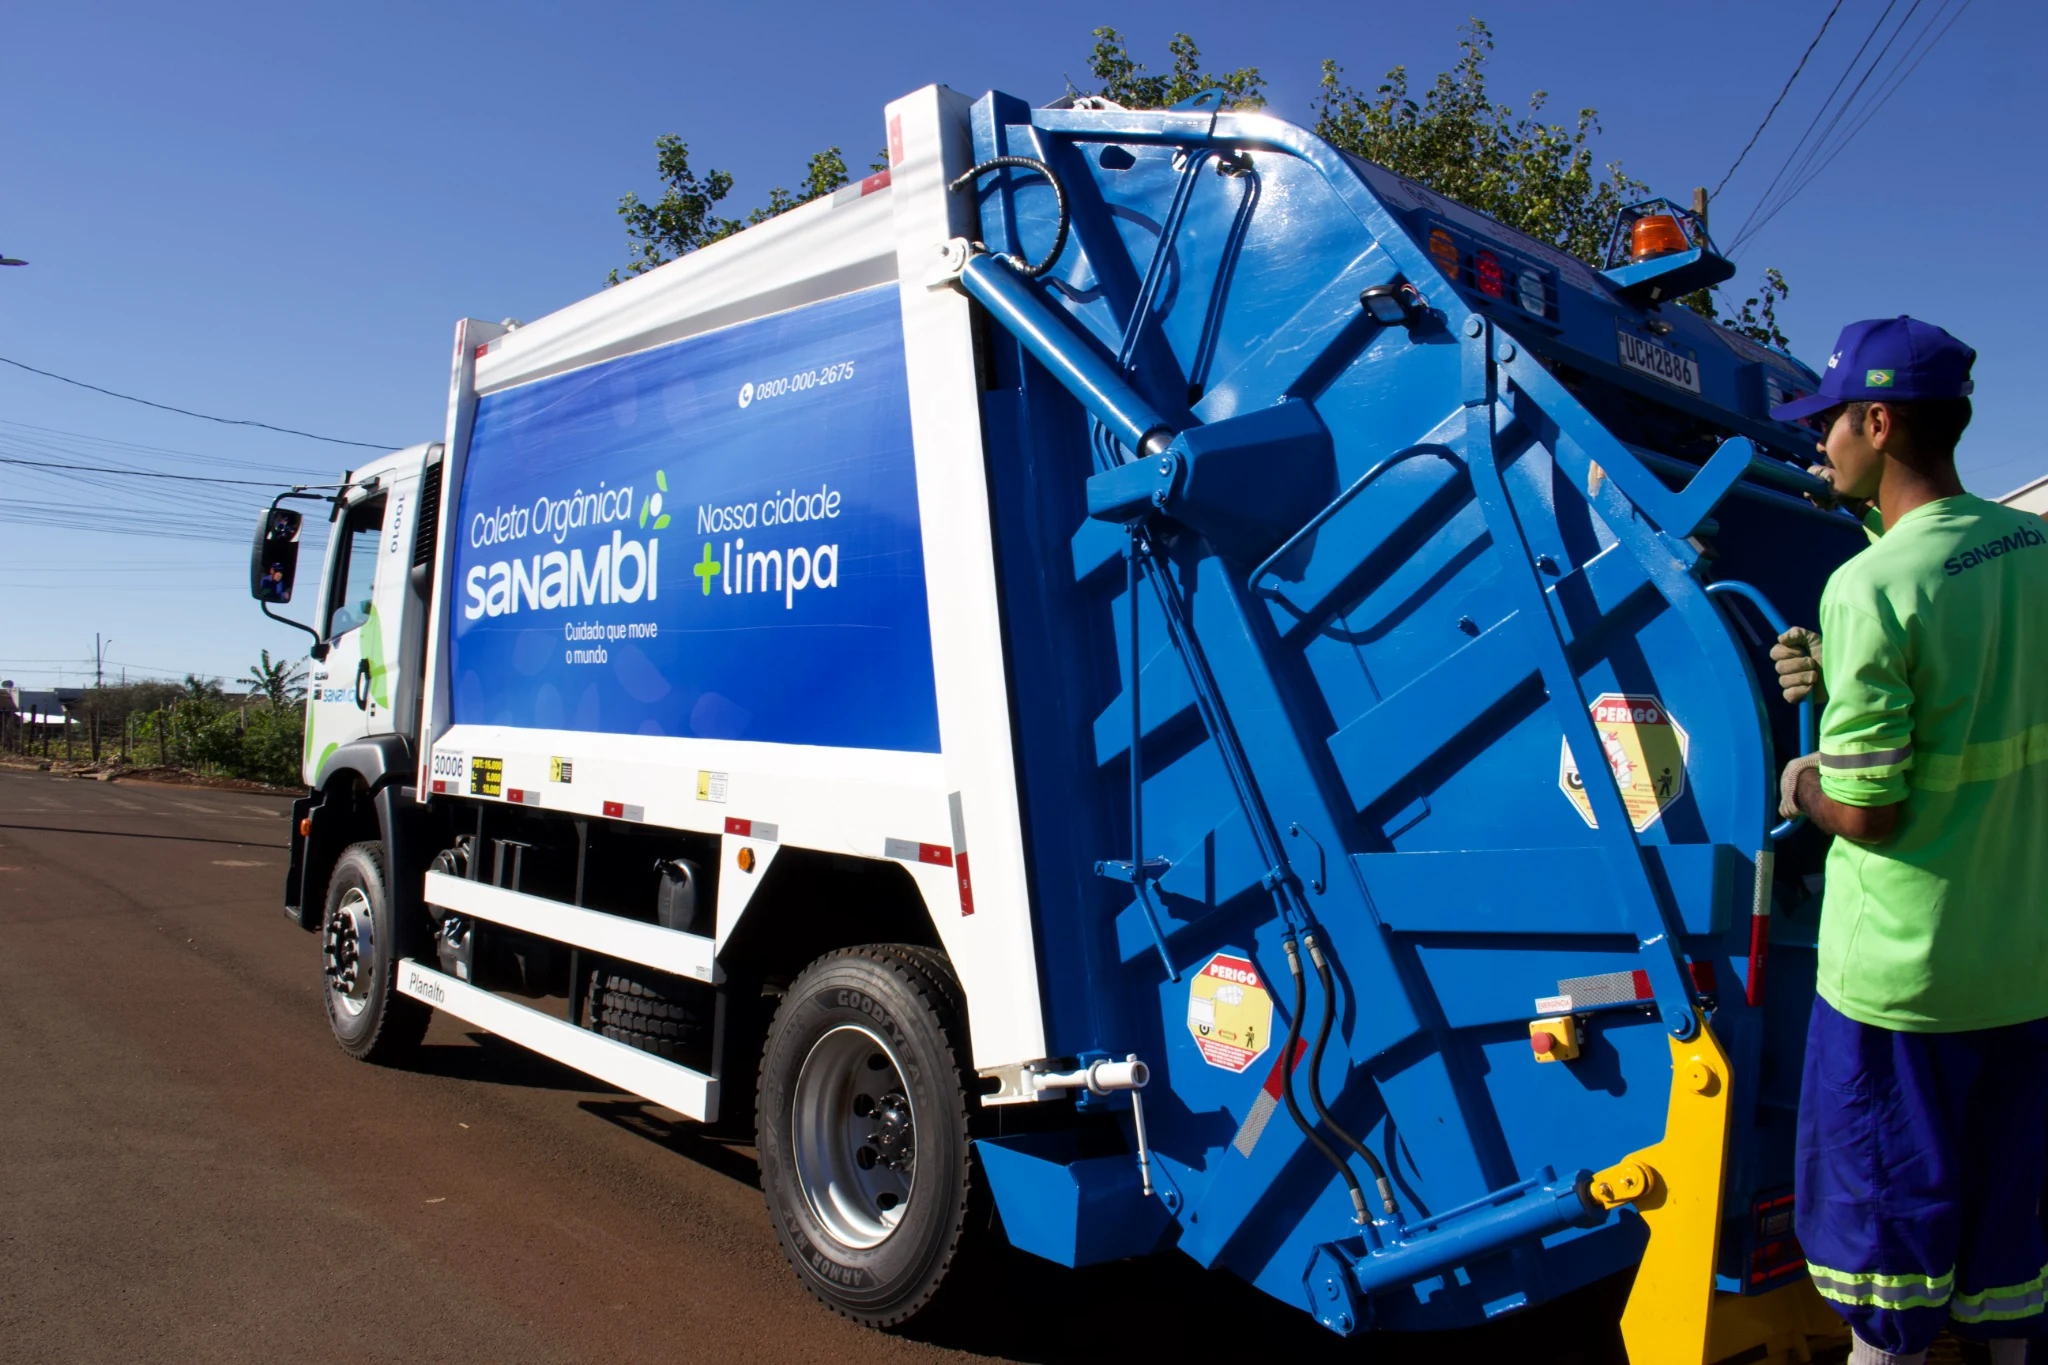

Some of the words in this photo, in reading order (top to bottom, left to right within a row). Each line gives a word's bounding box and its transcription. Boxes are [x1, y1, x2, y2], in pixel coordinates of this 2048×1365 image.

[1624, 334, 1692, 386] UCH2B86
[756, 361, 855, 401] 0800-000-2675
[390, 493, 406, 554] 10010
[471, 506, 530, 549] Coleta
[532, 481, 634, 545] Orgânica
[697, 503, 758, 535] Nossa
[762, 483, 842, 526] cidade
[565, 620, 605, 641] Cuidado
[606, 624, 628, 643] que
[628, 622, 659, 639] move
[565, 650, 573, 665] o
[574, 644, 608, 664] mundo
[1596, 706, 1658, 724] PERIGO
[434, 754, 464, 778] 30006
[409, 972, 445, 1004] Planalto
[1210, 963, 1257, 986] PERIGO
[837, 990, 928, 1108] GOODYEAR
[782, 1208, 808, 1251] MAX
[811, 1251, 863, 1287] ARMOR
